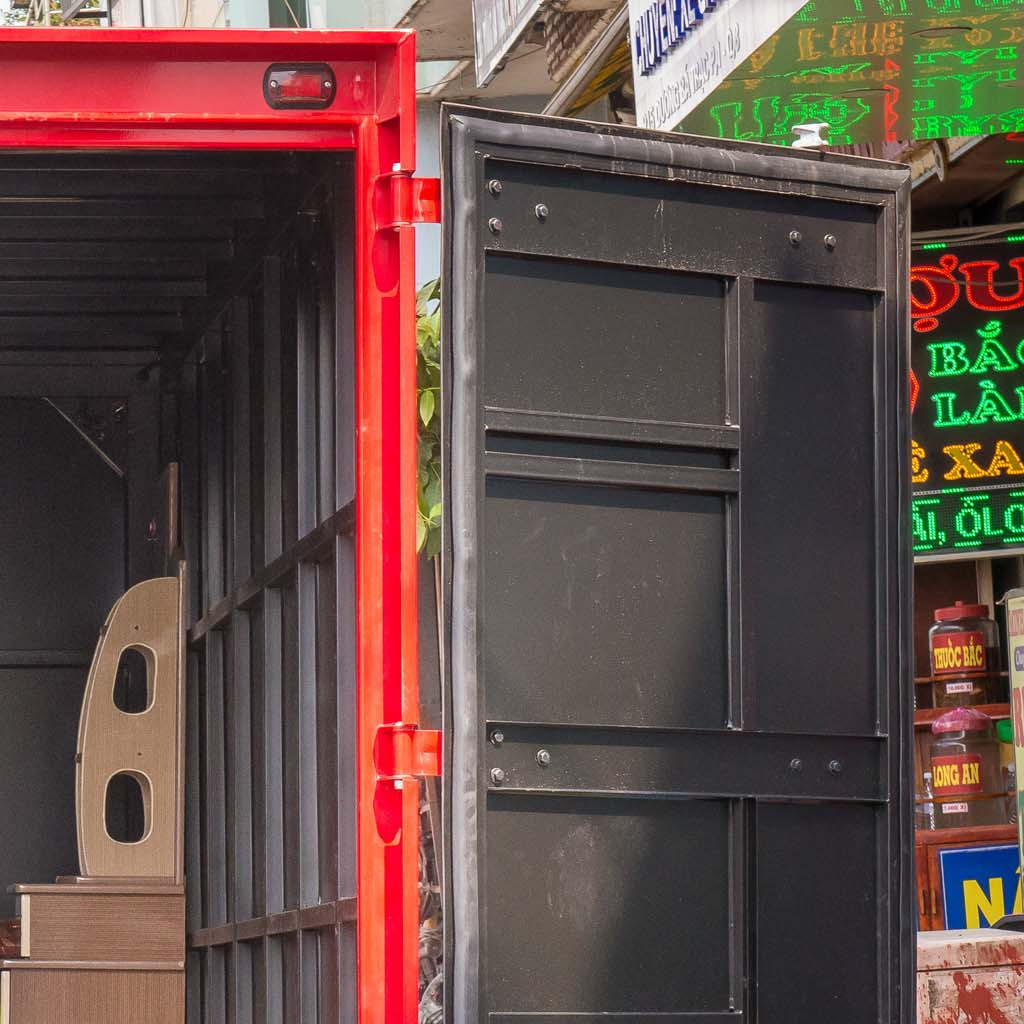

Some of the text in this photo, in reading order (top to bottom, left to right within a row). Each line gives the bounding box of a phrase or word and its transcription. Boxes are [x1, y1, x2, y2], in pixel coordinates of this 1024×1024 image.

[927, 320, 1024, 377] BẮ
[932, 379, 1024, 427] LÀ
[933, 762, 980, 788] LONG AN
[963, 866, 1023, 929] N
